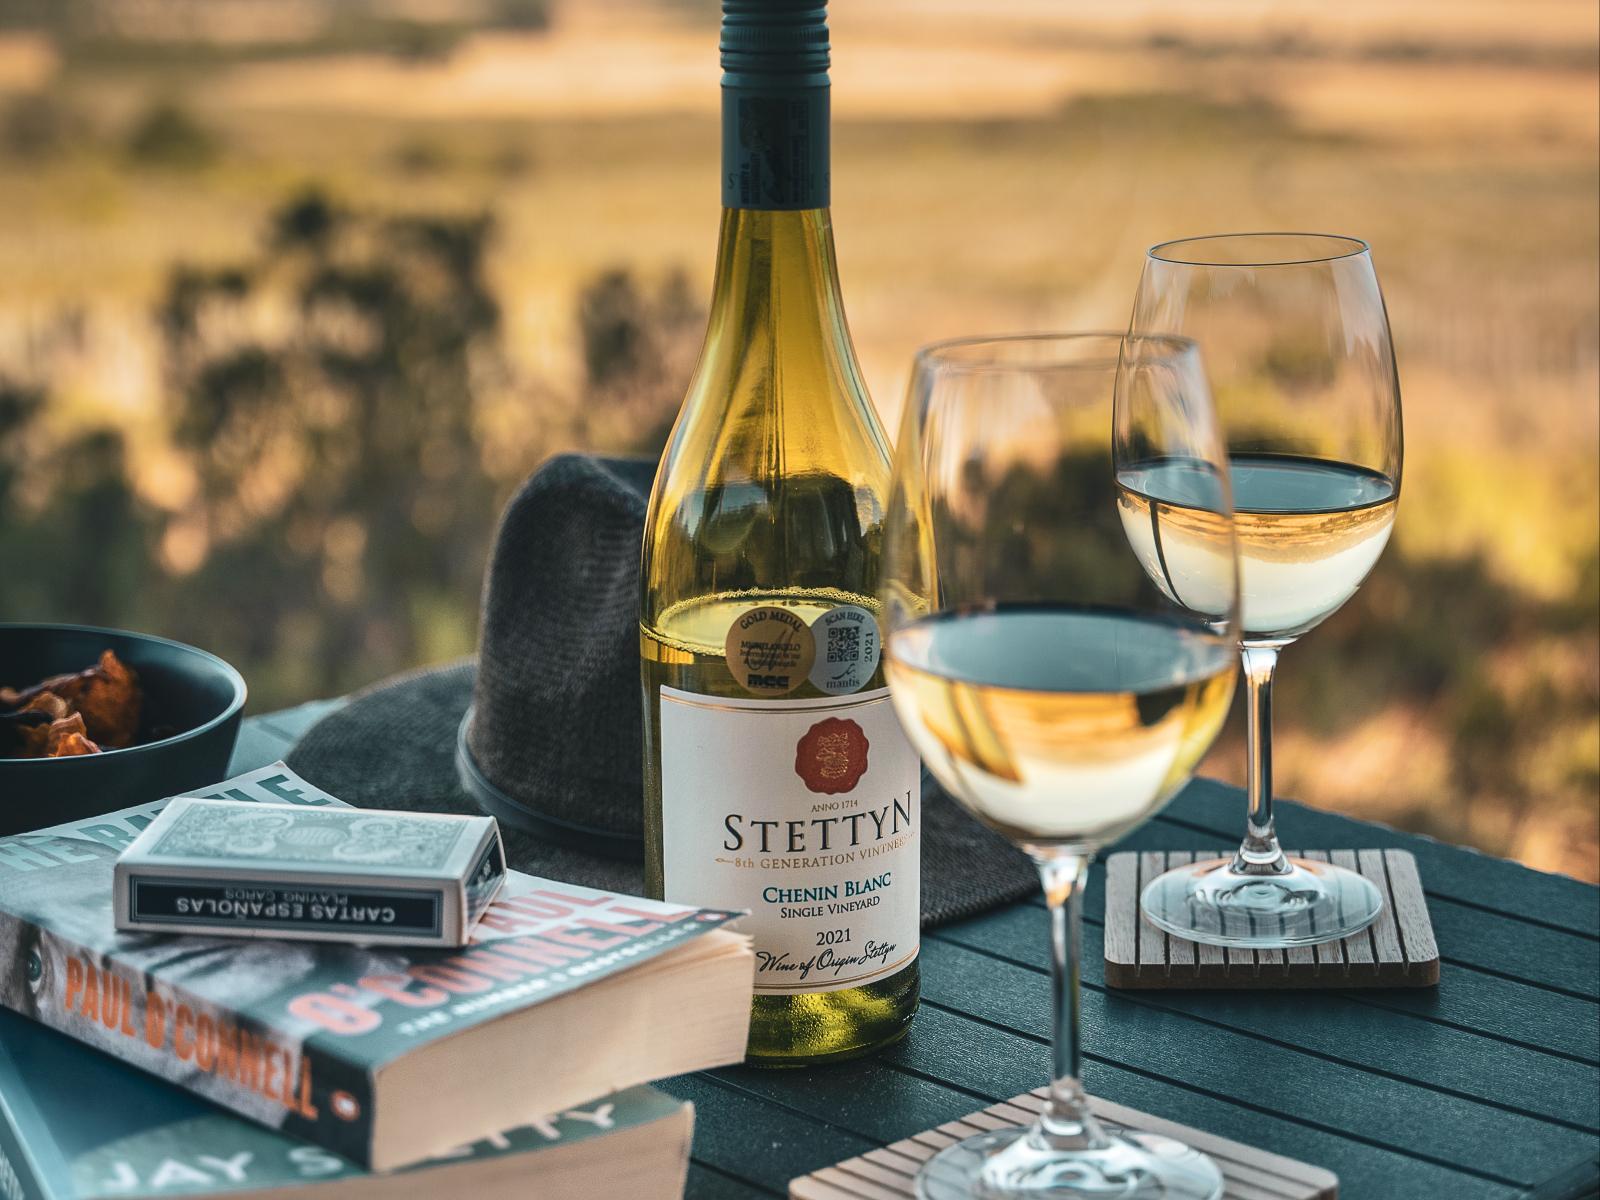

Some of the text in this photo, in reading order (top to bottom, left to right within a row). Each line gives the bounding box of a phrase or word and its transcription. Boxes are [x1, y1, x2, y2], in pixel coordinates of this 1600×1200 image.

[740, 610, 803, 633] GOLD MEDAL
[825, 611, 847, 627] SCAN
[863, 631, 874, 663] 2021
[826, 677, 860, 689] mantis
[811, 799, 858, 813] ANNO 1714
[723, 790, 911, 853] STETTYN
[735, 857, 755, 869] 8th
[760, 851, 856, 870] GENERATION
[225, 887, 348, 905] PLAYING CARDS
[762, 872, 892, 904] CHENIN BLANC
[176, 897, 396, 923] CARTAS ESPAÑOLAS
[476, 889, 615, 933] AUL
[780, 895, 881, 919] SINGLE VINEYARD
[815, 927, 851, 946] 2021
[287, 904, 698, 1036] O'CONNELL
[756, 940, 897, 980] Wine of Origin Stettyn
[63, 956, 320, 1121] PAUL O'CONNELL
[103, 1150, 253, 1189] JAY
